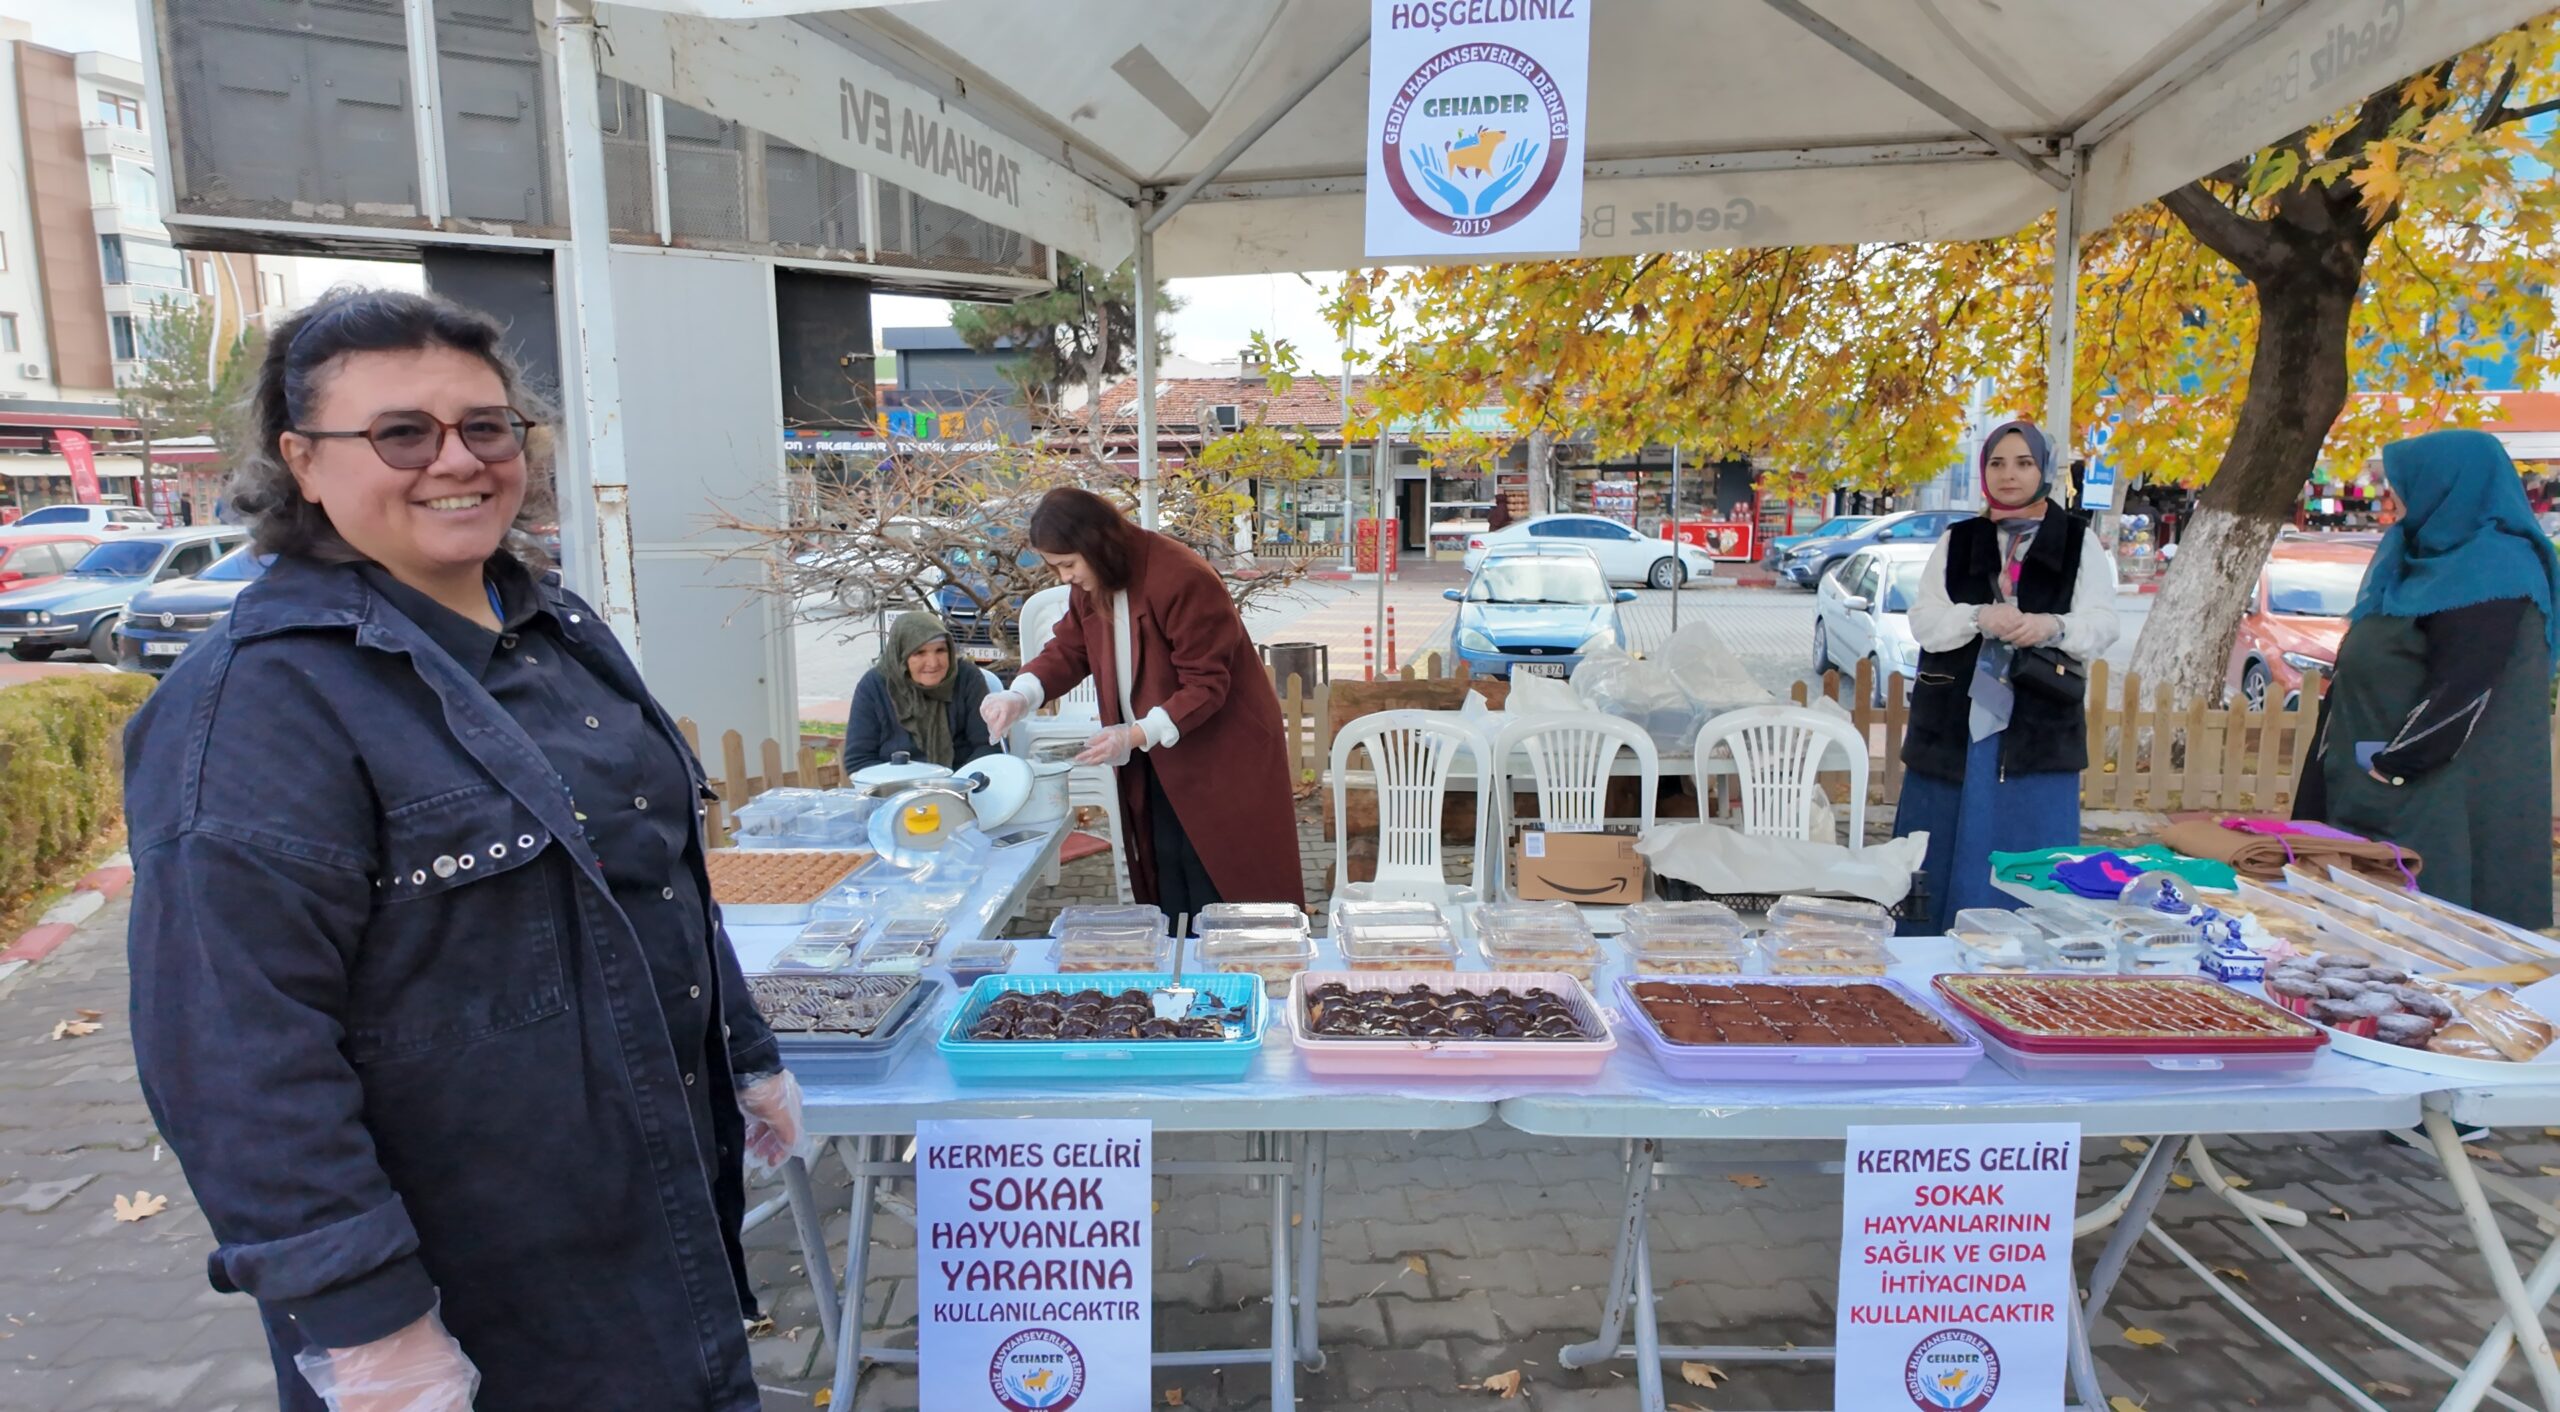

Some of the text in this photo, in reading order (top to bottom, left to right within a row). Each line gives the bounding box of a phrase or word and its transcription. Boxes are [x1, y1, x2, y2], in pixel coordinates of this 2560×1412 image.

[1385, 46, 1569, 145] GEDİZ HAYVANSEVERLER DERNEĞİ
[1423, 94, 1529, 118] GEHADER
[1452, 219, 1491, 235] 2019
[929, 1138, 1142, 1169] KERMES GELİRİ
[1857, 1141, 2070, 1173] KERMES GELİRİ
[969, 1177, 1104, 1211] SOKAK
[1914, 1184, 2004, 1207] SOKAK
[932, 1220, 1141, 1249] HAYVANLARI
[1864, 1214, 2051, 1235] HAYVANLARININ
[1864, 1240, 2047, 1264] SAĞLIK VE GIDA
[941, 1259, 1133, 1291] YARARINA
[1881, 1270, 2027, 1293] İHTİYACINDA
[934, 1301, 1140, 1322] KULLANILACAKTIR
[1850, 1304, 2055, 1324] KULLANILACAKTIR
[993, 1331, 1073, 1370] HAYVANSEVERLER
[1068, 1353, 1082, 1399] DERNEĞİ
[1011, 1354, 1063, 1364] GEHADER
[1909, 1332, 1989, 1370] HAYVANSEVERLER
[1982, 1353, 1998, 1399] DERNEĞİ
[1926, 1354, 1980, 1364] GEHADER
